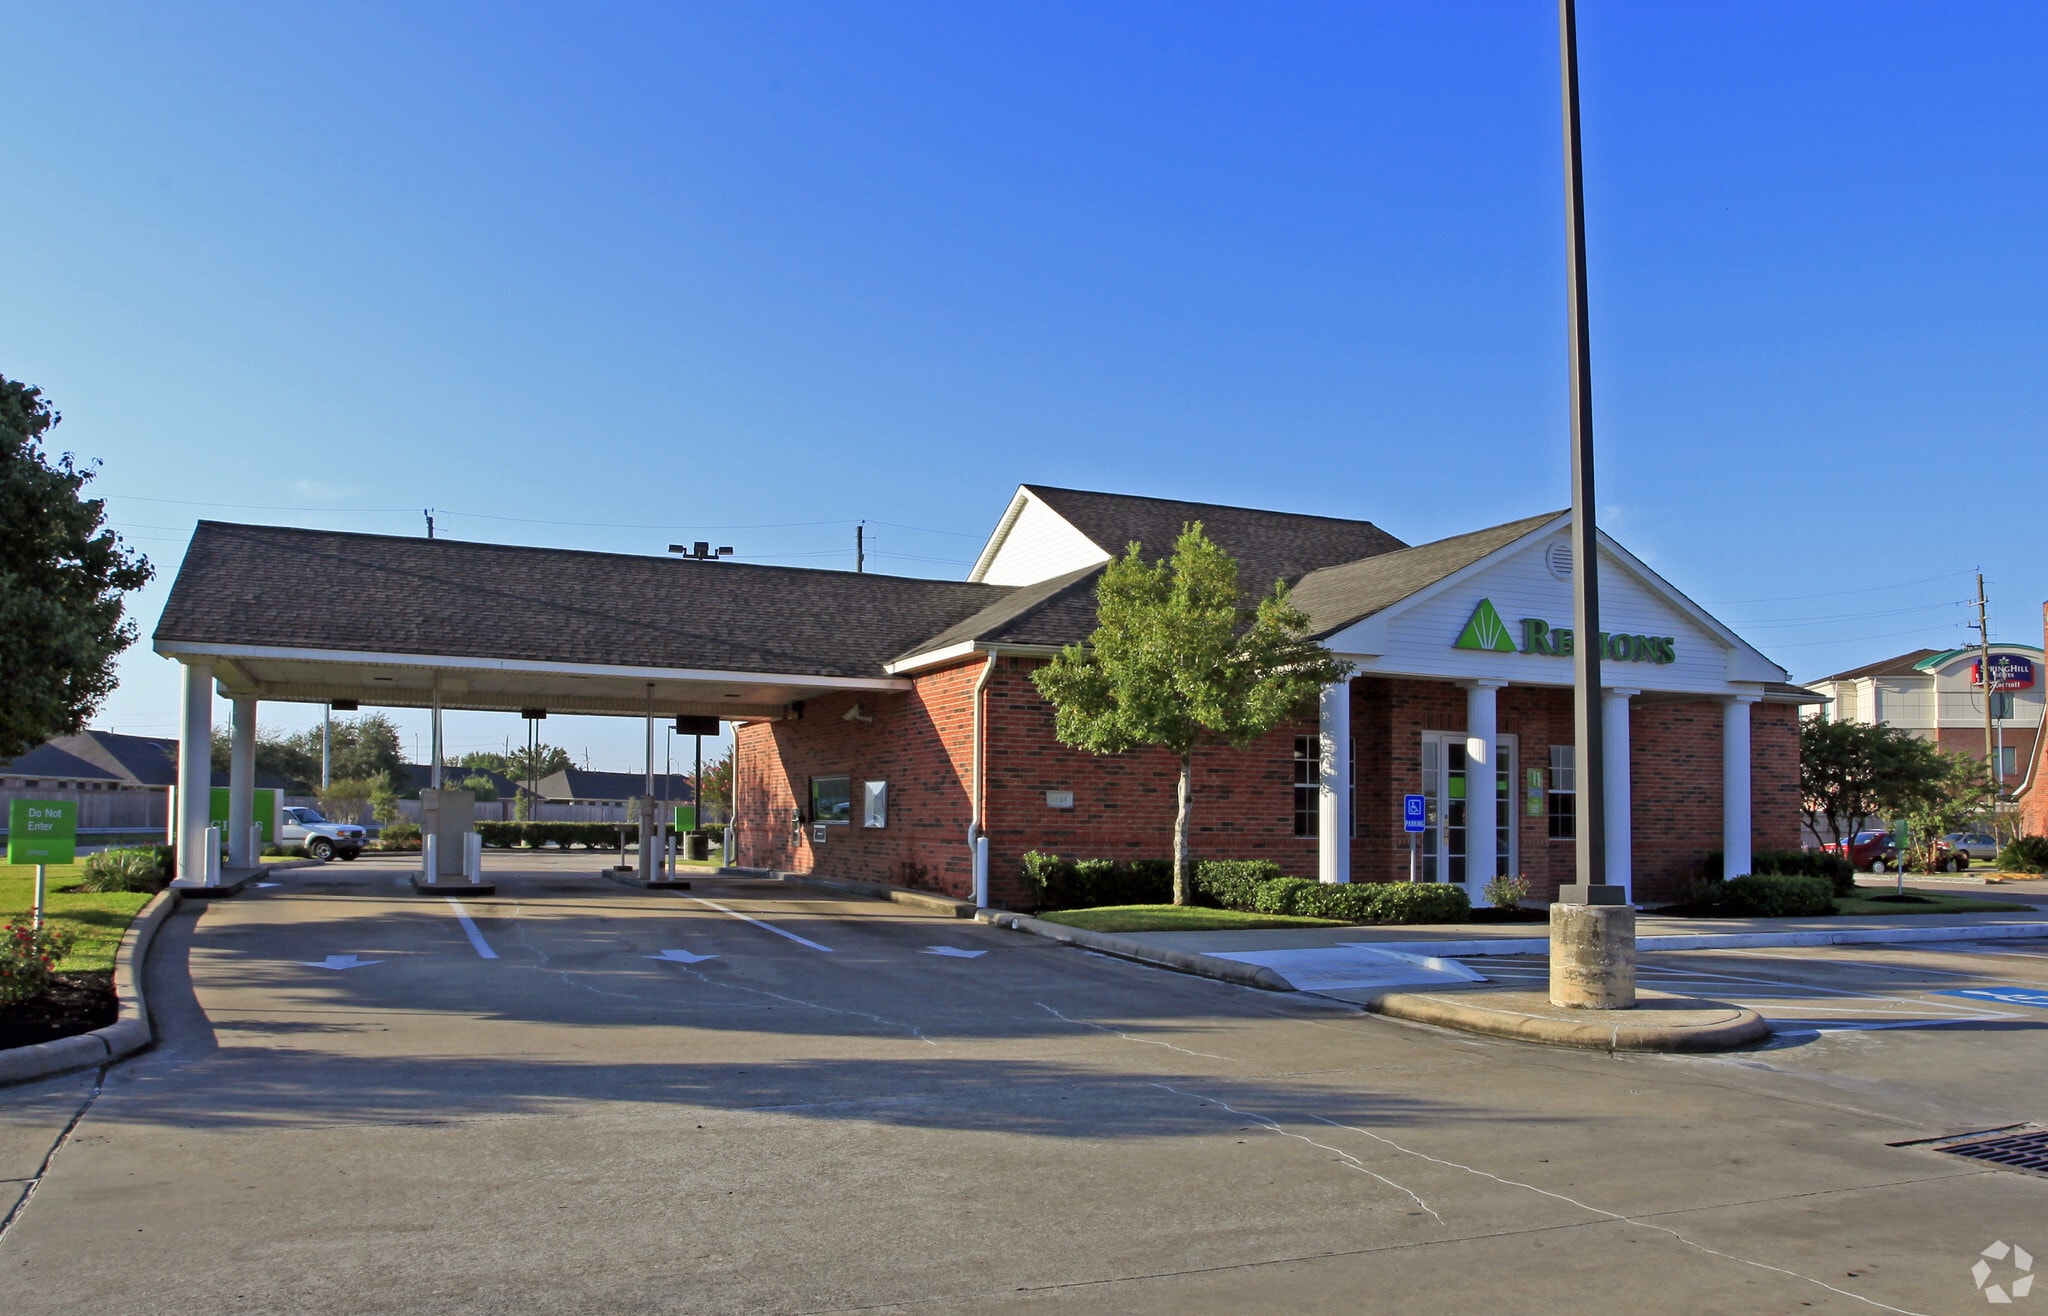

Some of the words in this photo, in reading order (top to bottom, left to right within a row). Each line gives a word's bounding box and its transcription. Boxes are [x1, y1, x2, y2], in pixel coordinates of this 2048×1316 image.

[1519, 618, 1676, 664] REIONS
[28, 808, 42, 818] Do
[45, 808, 62, 818] Not
[28, 821, 53, 831] Enter
